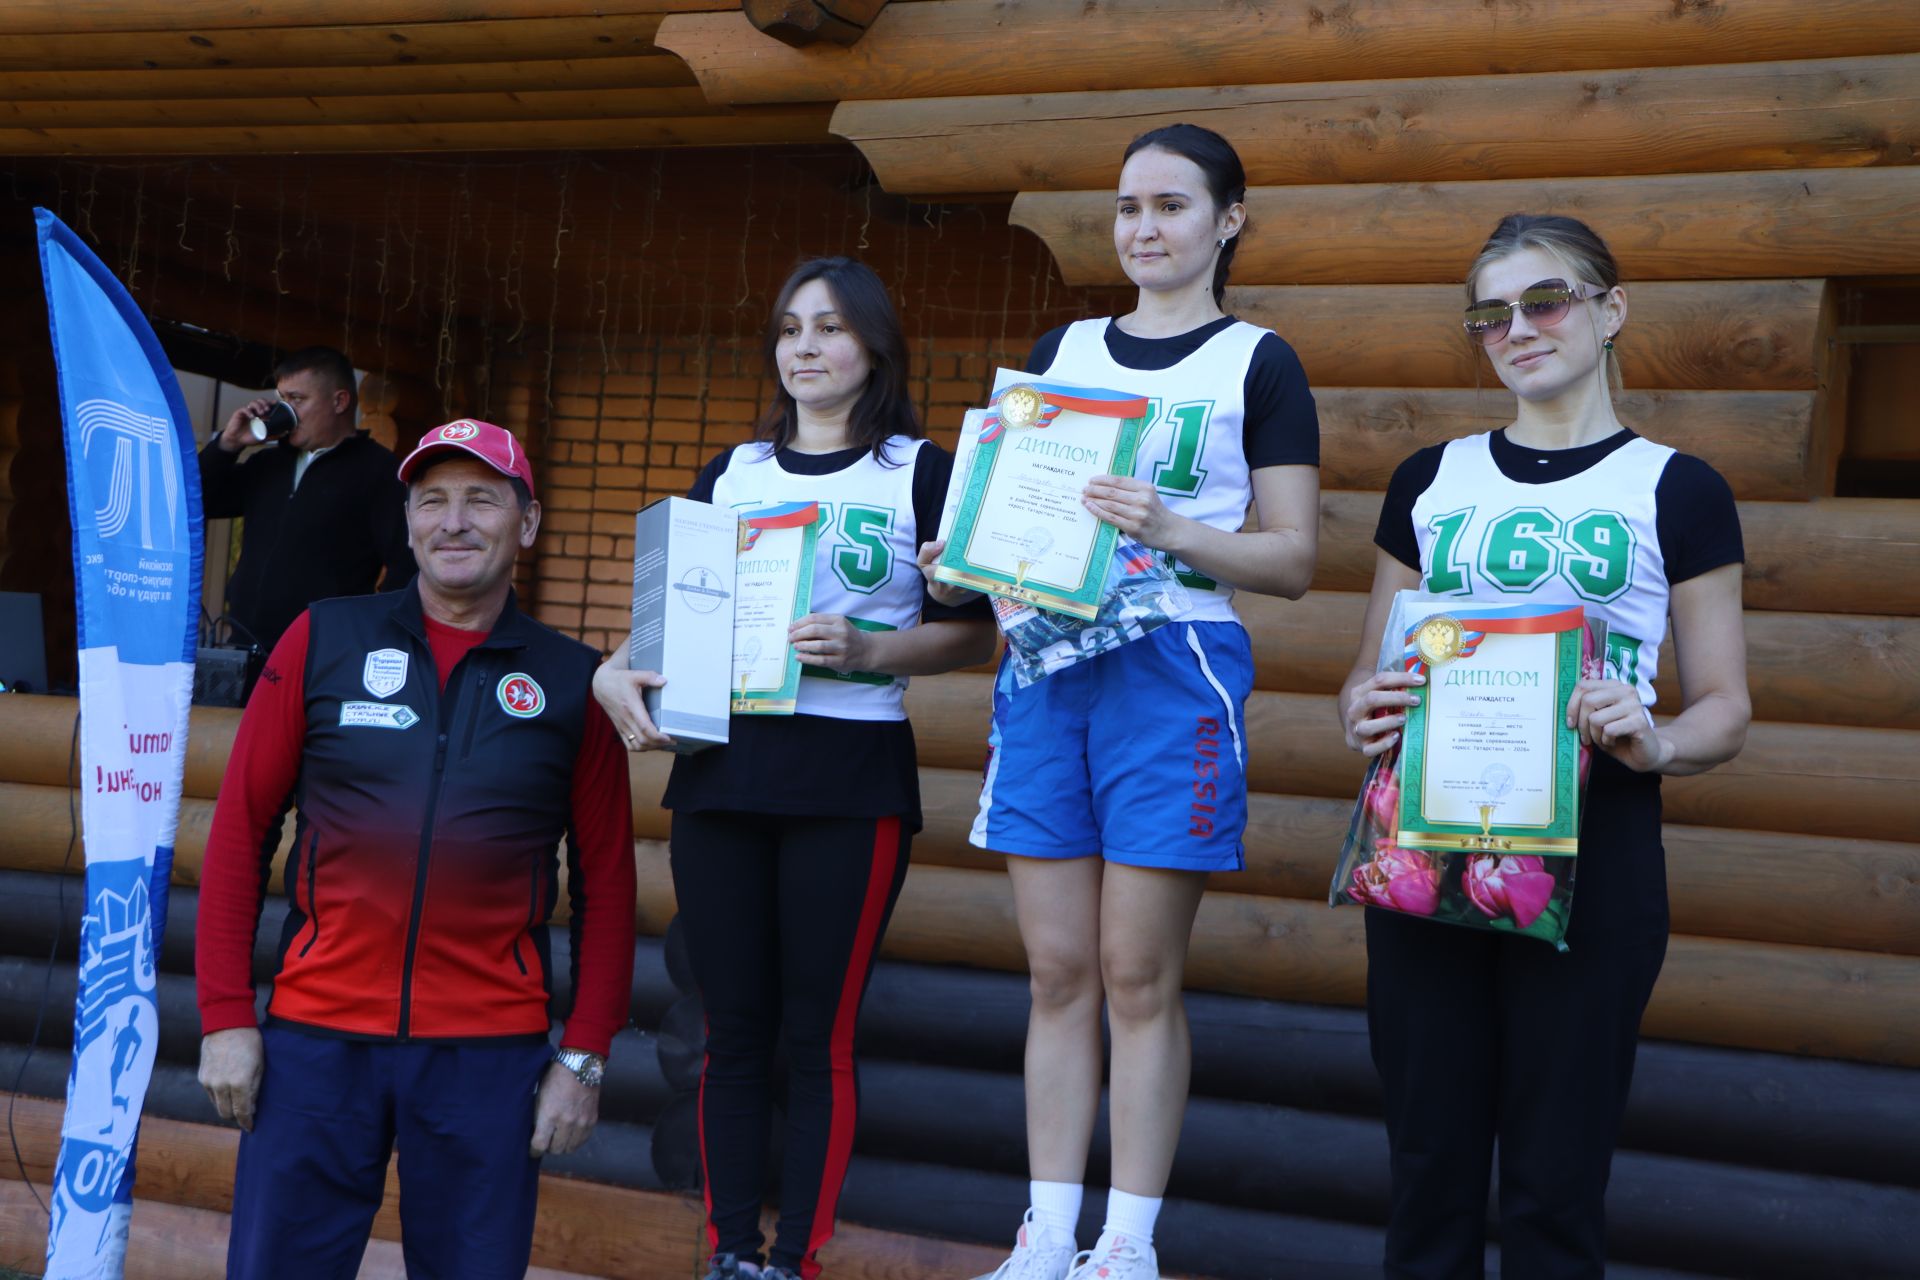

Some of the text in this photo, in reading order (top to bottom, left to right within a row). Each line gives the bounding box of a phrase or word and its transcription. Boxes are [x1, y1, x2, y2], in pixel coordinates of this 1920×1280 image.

[1015, 436, 1099, 465] ДИПЛОМ
[1423, 505, 1637, 604] 169
[1444, 669, 1539, 688] ДИПЛОМ
[1188, 716, 1220, 838] RUSSIA
